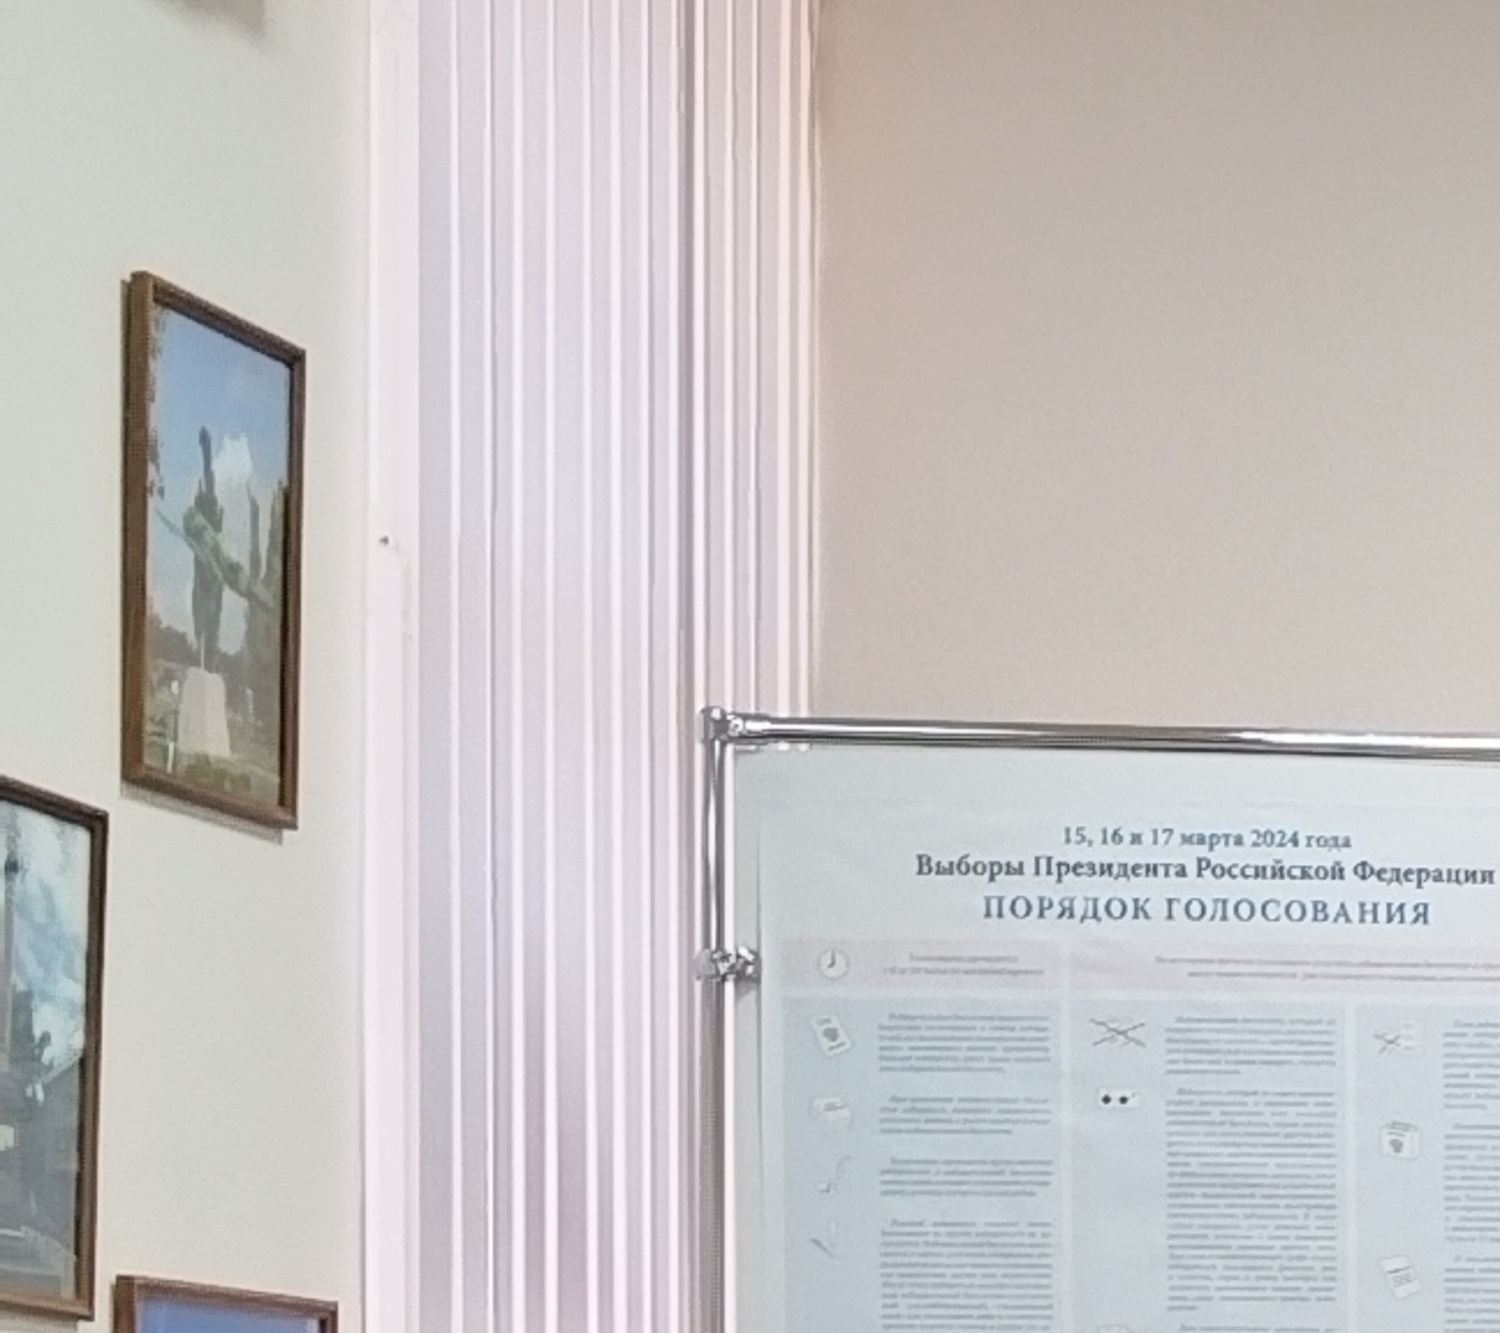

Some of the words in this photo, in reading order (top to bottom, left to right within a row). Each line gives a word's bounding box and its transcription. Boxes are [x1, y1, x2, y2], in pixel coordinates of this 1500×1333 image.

[1063, 827, 1094, 847] 15,
[1100, 827, 1124, 846] 16
[1129, 831, 1143, 846] и
[1150, 828, 1175, 846] 17
[1179, 831, 1245, 852] марта
[1250, 829, 1300, 848] 2024
[1305, 834, 1352, 852] года
[916, 854, 1025, 882] Выборы
[1033, 855, 1188, 884] Президента
[1196, 856, 1346, 882] Российской
[1352, 860, 1496, 888] Федерации
[983, 895, 1153, 923] ПОРЯДОК
[1164, 897, 1431, 926] ГОЛОСОВАНИЯ
